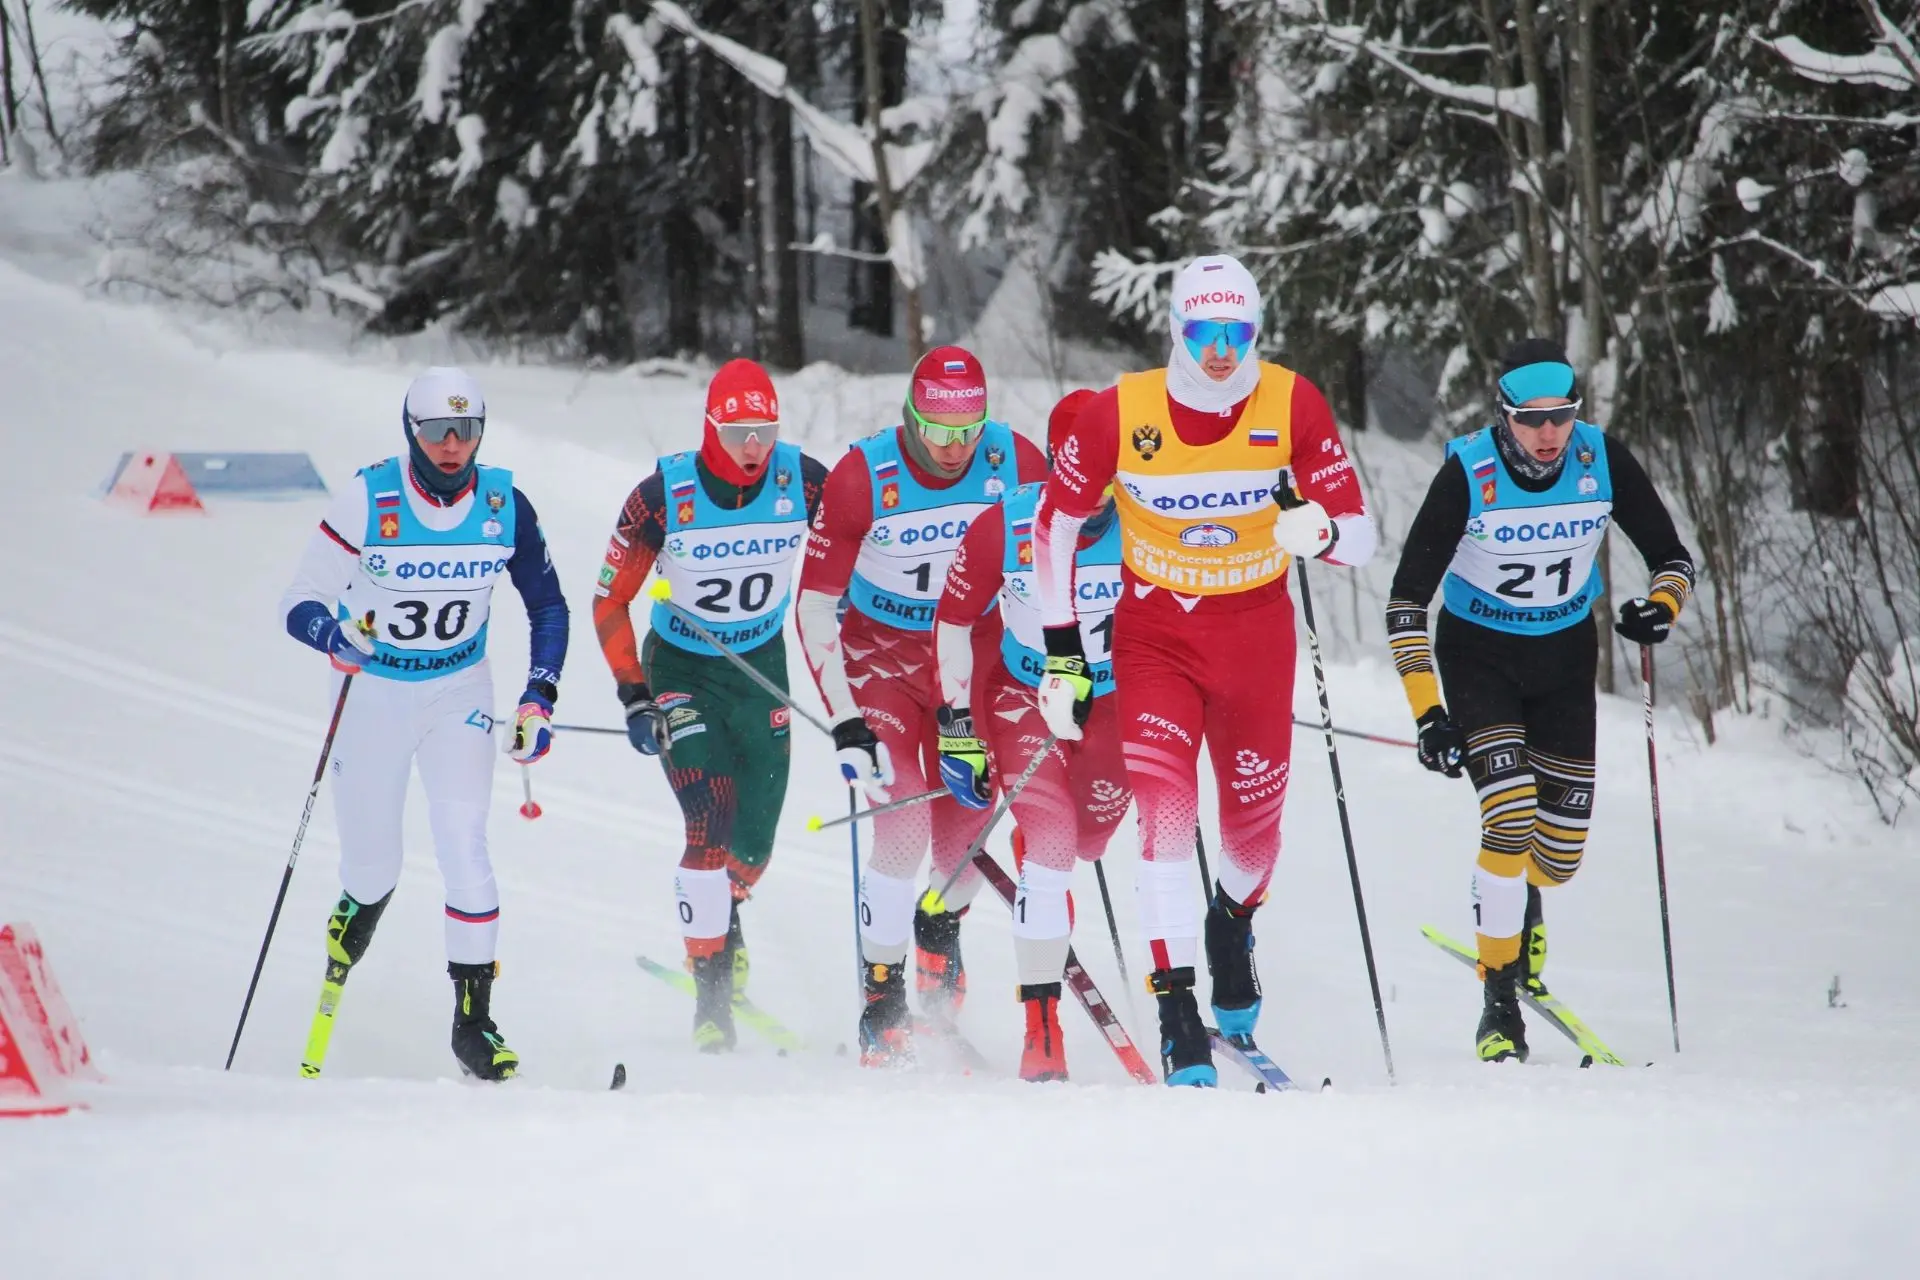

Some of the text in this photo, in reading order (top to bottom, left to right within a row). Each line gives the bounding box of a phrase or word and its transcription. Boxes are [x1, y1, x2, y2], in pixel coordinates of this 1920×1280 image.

[1185, 290, 1244, 312] ЛУКОЙЛ
[1311, 458, 1352, 484] ЛУКОЙ
[899, 520, 968, 546] ФОСА
[1494, 515, 1611, 543] ФОСАГРО
[692, 534, 801, 560] ФОСАГРО
[395, 558, 508, 580] ФОСАГРО
[1132, 547, 1285, 587] СЫКТЫВКАР
[1494, 556, 1573, 599] 21
[695, 572, 773, 614] 20
[388, 599, 471, 640] 30
[1136, 712, 1192, 747] ЛУКОЙЛ
[1231, 762, 1288, 790] ФОСАГРО
